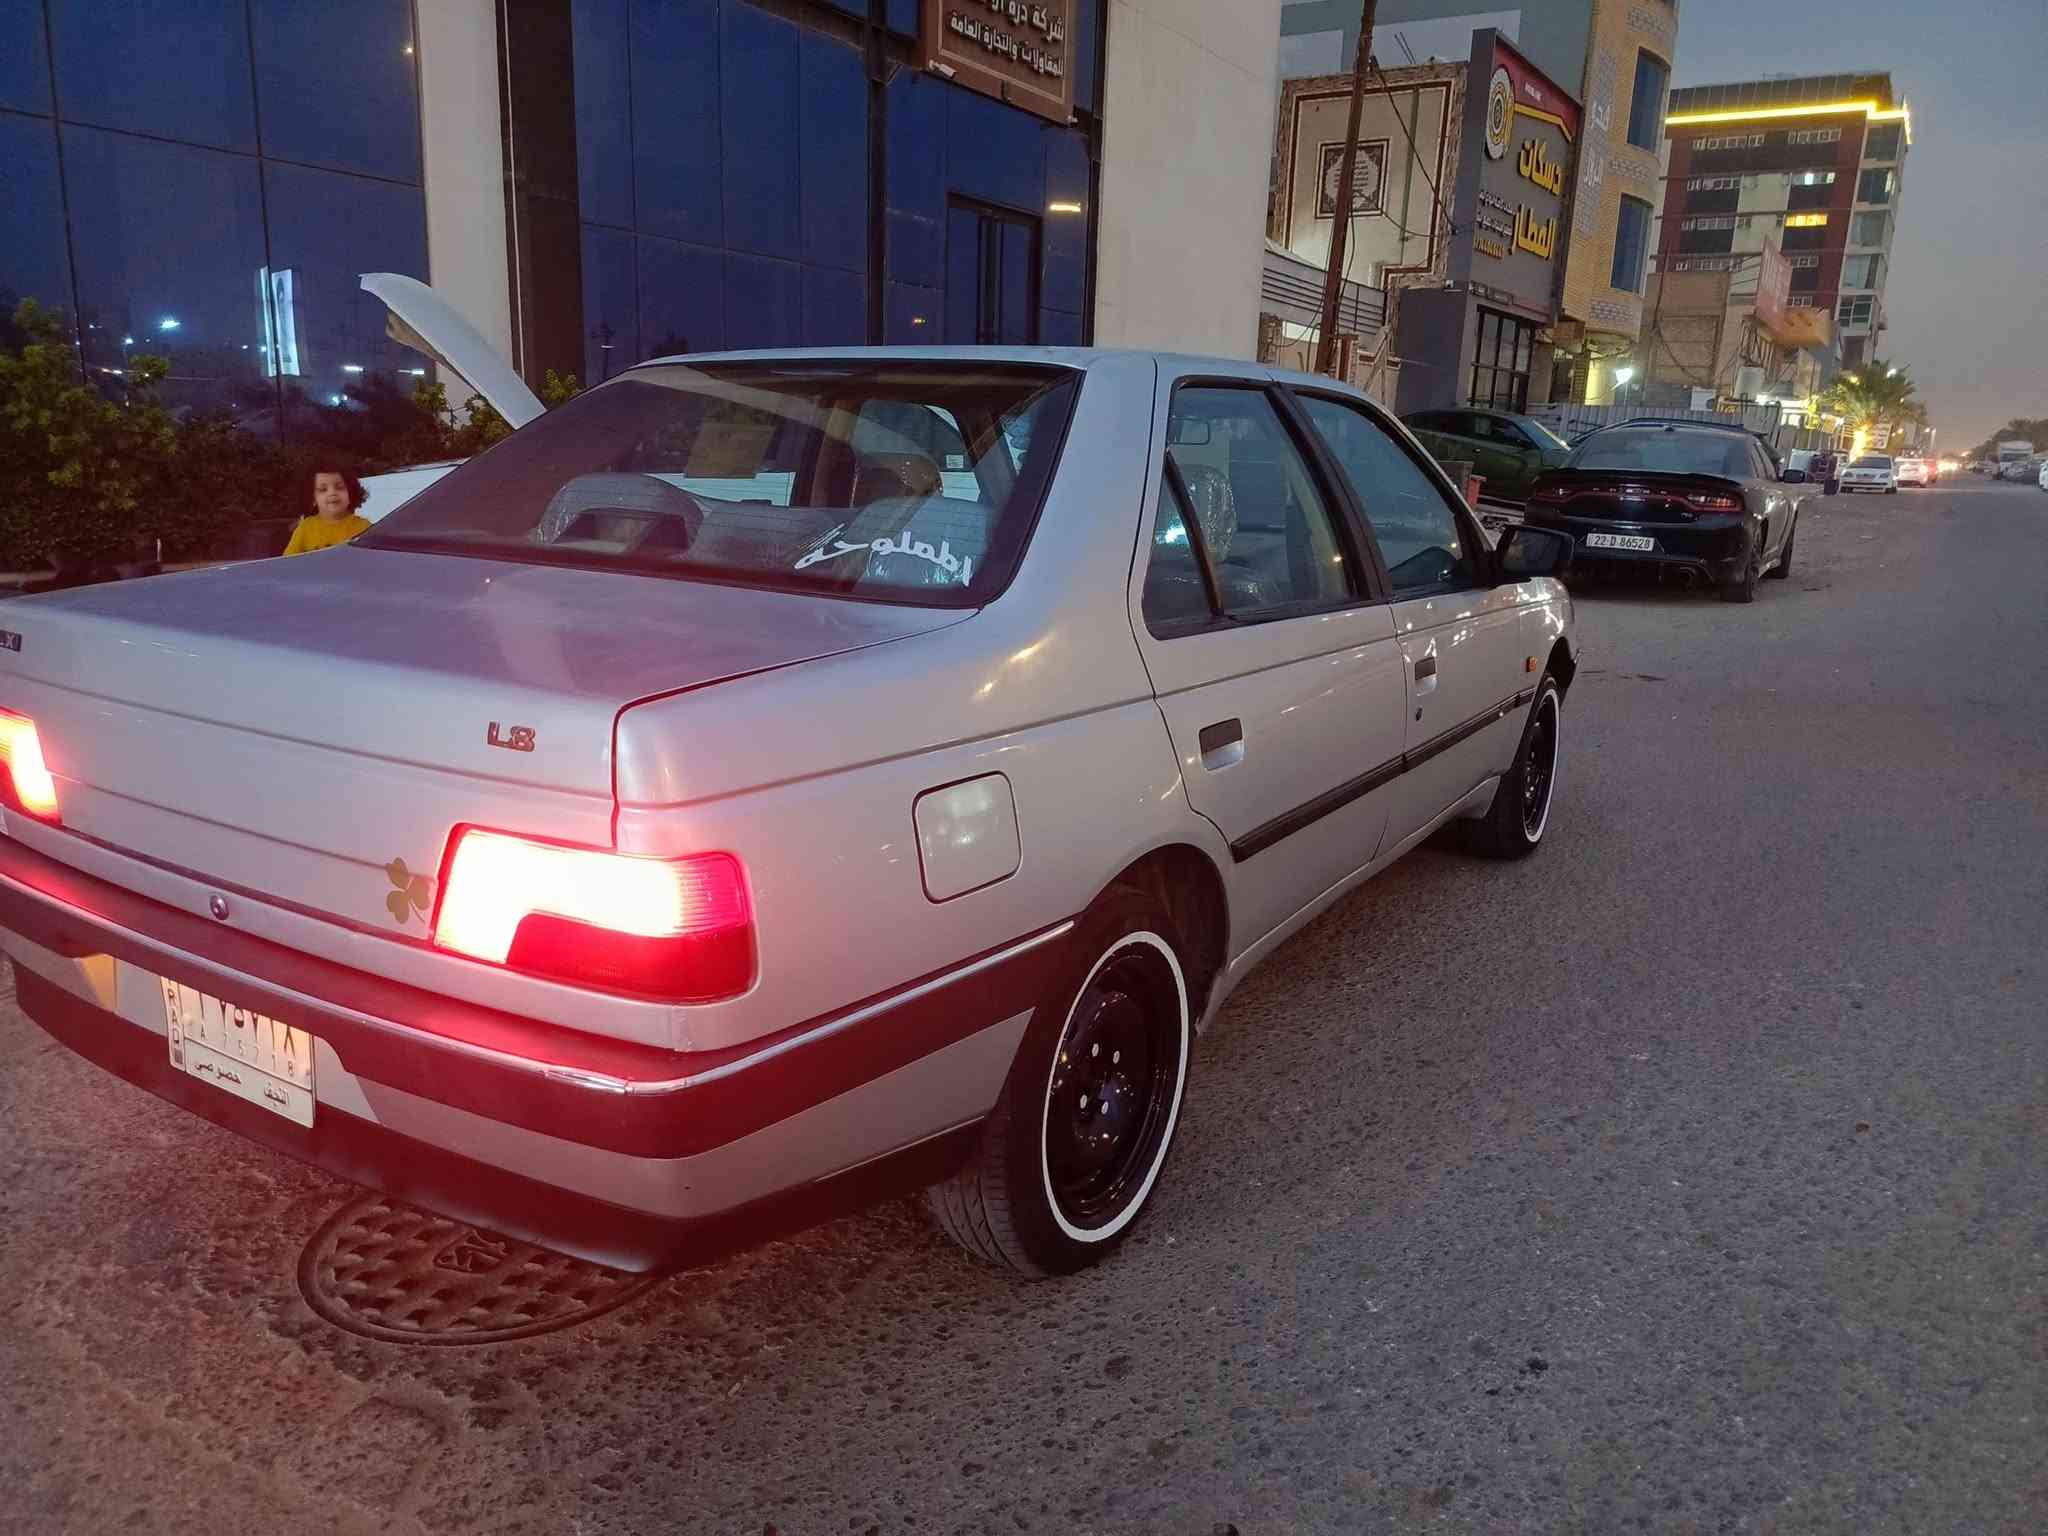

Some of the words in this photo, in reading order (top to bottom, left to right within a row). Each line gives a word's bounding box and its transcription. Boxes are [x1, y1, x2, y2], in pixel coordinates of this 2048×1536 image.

[951, 11, 981, 41] العامة
[1032, 6, 1064, 41] شركة
[984, 26, 1018, 60] والتجارة
[1022, 40, 1064, 77] للمقاولات
